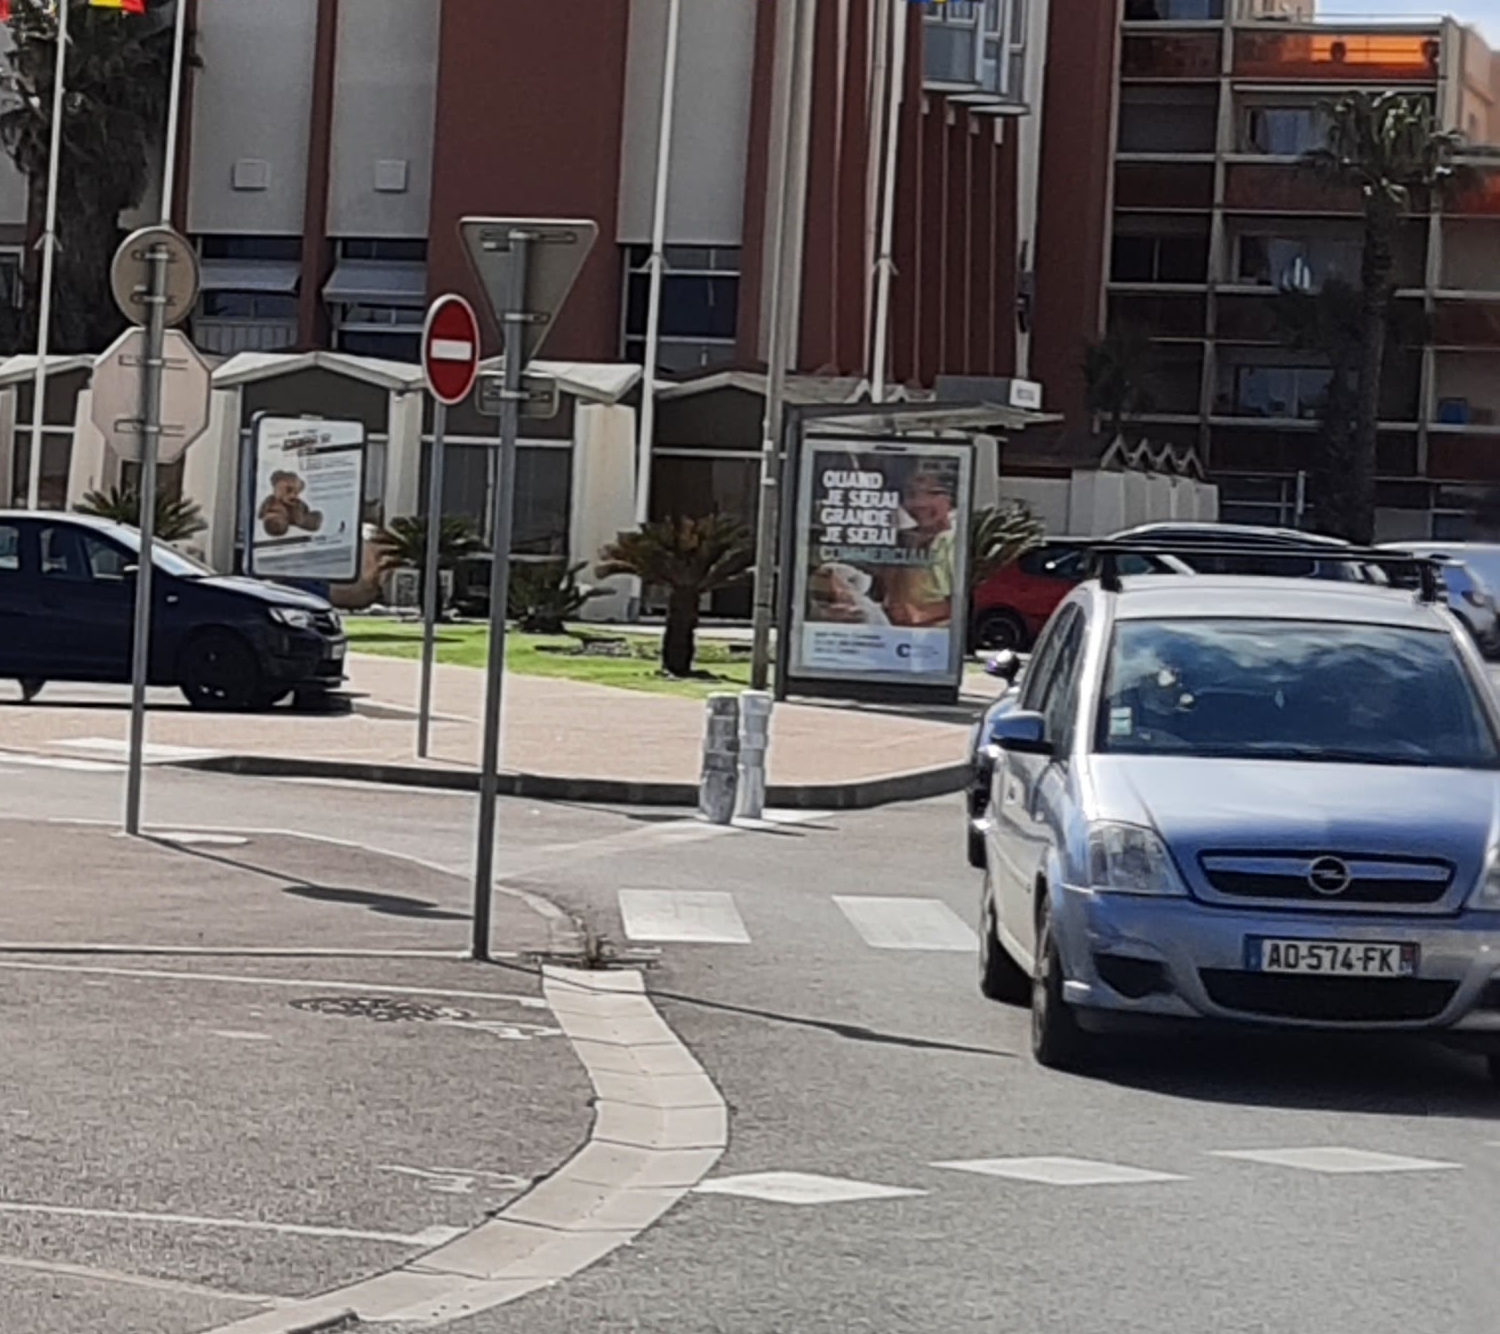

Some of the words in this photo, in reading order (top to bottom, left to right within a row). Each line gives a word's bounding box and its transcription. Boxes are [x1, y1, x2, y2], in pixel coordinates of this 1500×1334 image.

[823, 470, 884, 489] QUAND
[821, 489, 844, 506] JE
[848, 490, 900, 508] SERAI
[820, 508, 893, 526] GRANDE
[819, 526, 842, 543] JE
[846, 527, 898, 545] SERAI
